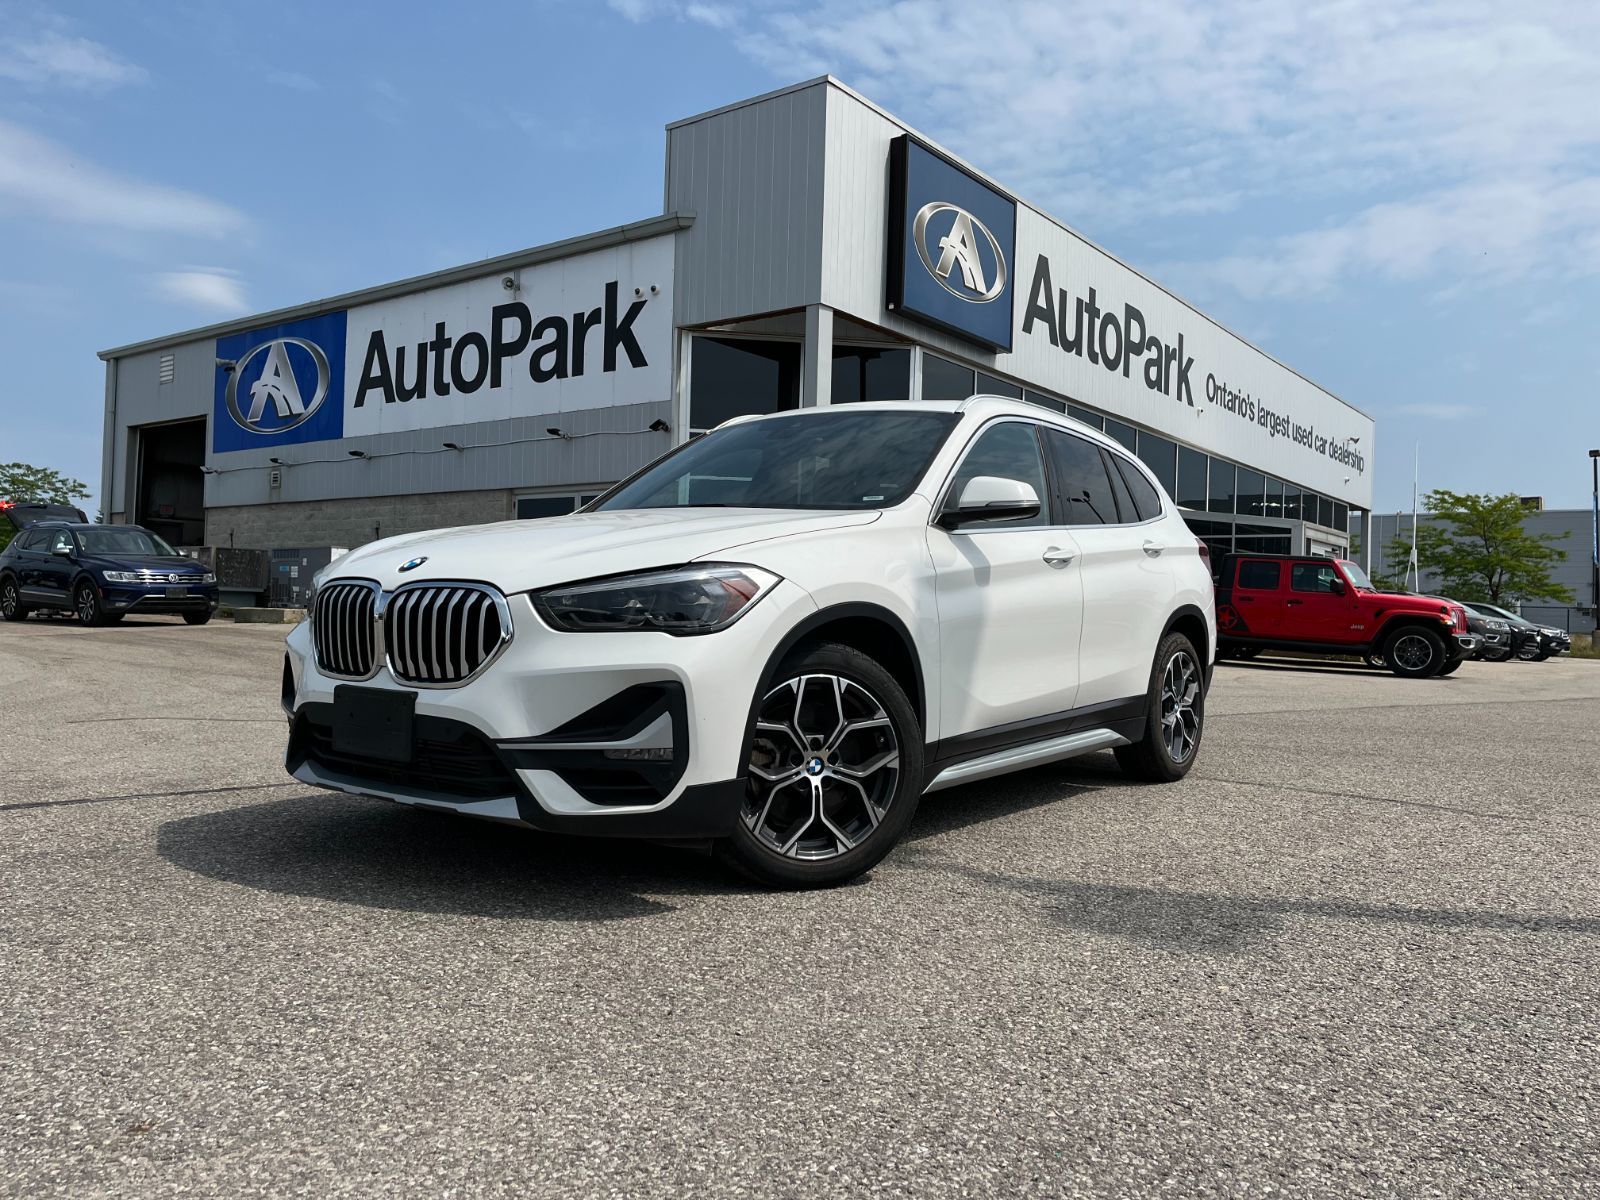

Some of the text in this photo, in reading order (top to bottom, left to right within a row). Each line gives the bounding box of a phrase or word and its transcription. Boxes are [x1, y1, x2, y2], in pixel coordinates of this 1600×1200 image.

[354, 281, 648, 408] AutoPark
[1022, 253, 1195, 407] AutoPark
[1206, 373, 1364, 476] Ontario's largest used car dealership
